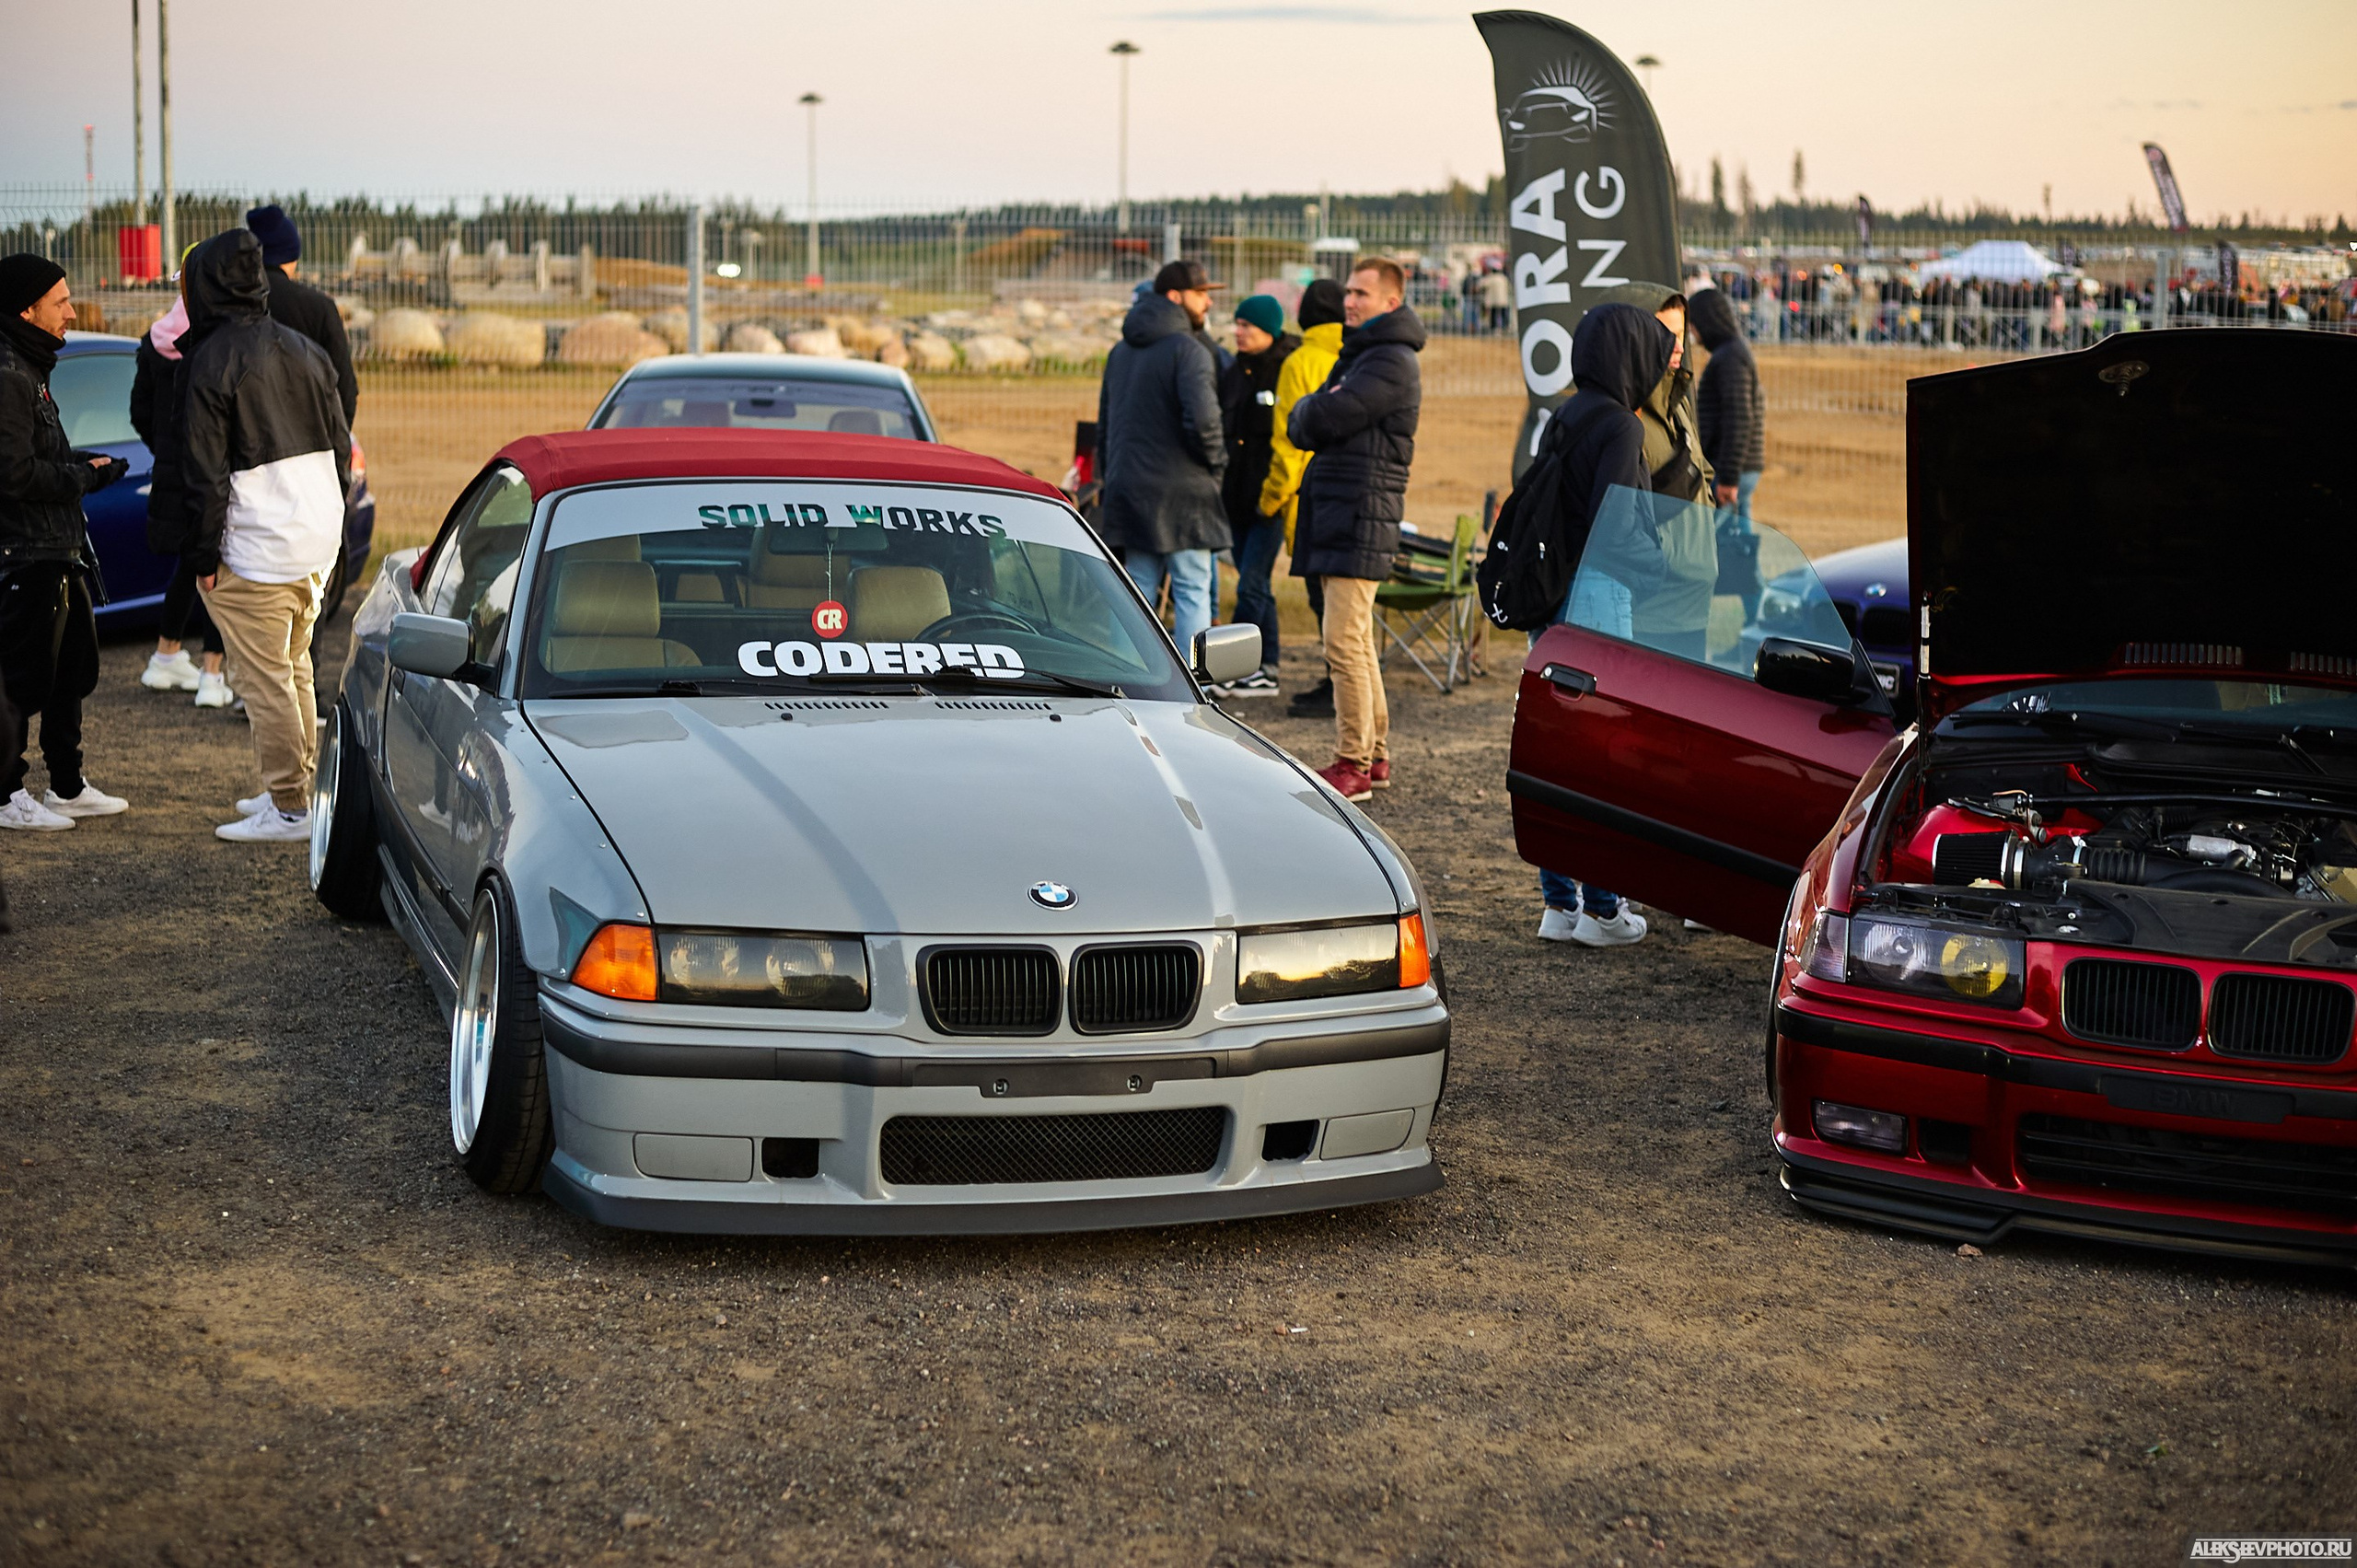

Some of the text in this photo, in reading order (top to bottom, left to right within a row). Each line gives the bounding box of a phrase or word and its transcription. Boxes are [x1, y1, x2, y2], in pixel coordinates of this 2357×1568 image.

[1575, 166, 1630, 315] NG
[698, 503, 1007, 540] SOLID WORKS
[817, 609, 842, 631] CR
[737, 640, 1026, 679] CODERED
[2154, 1086, 2235, 1115] BMW
